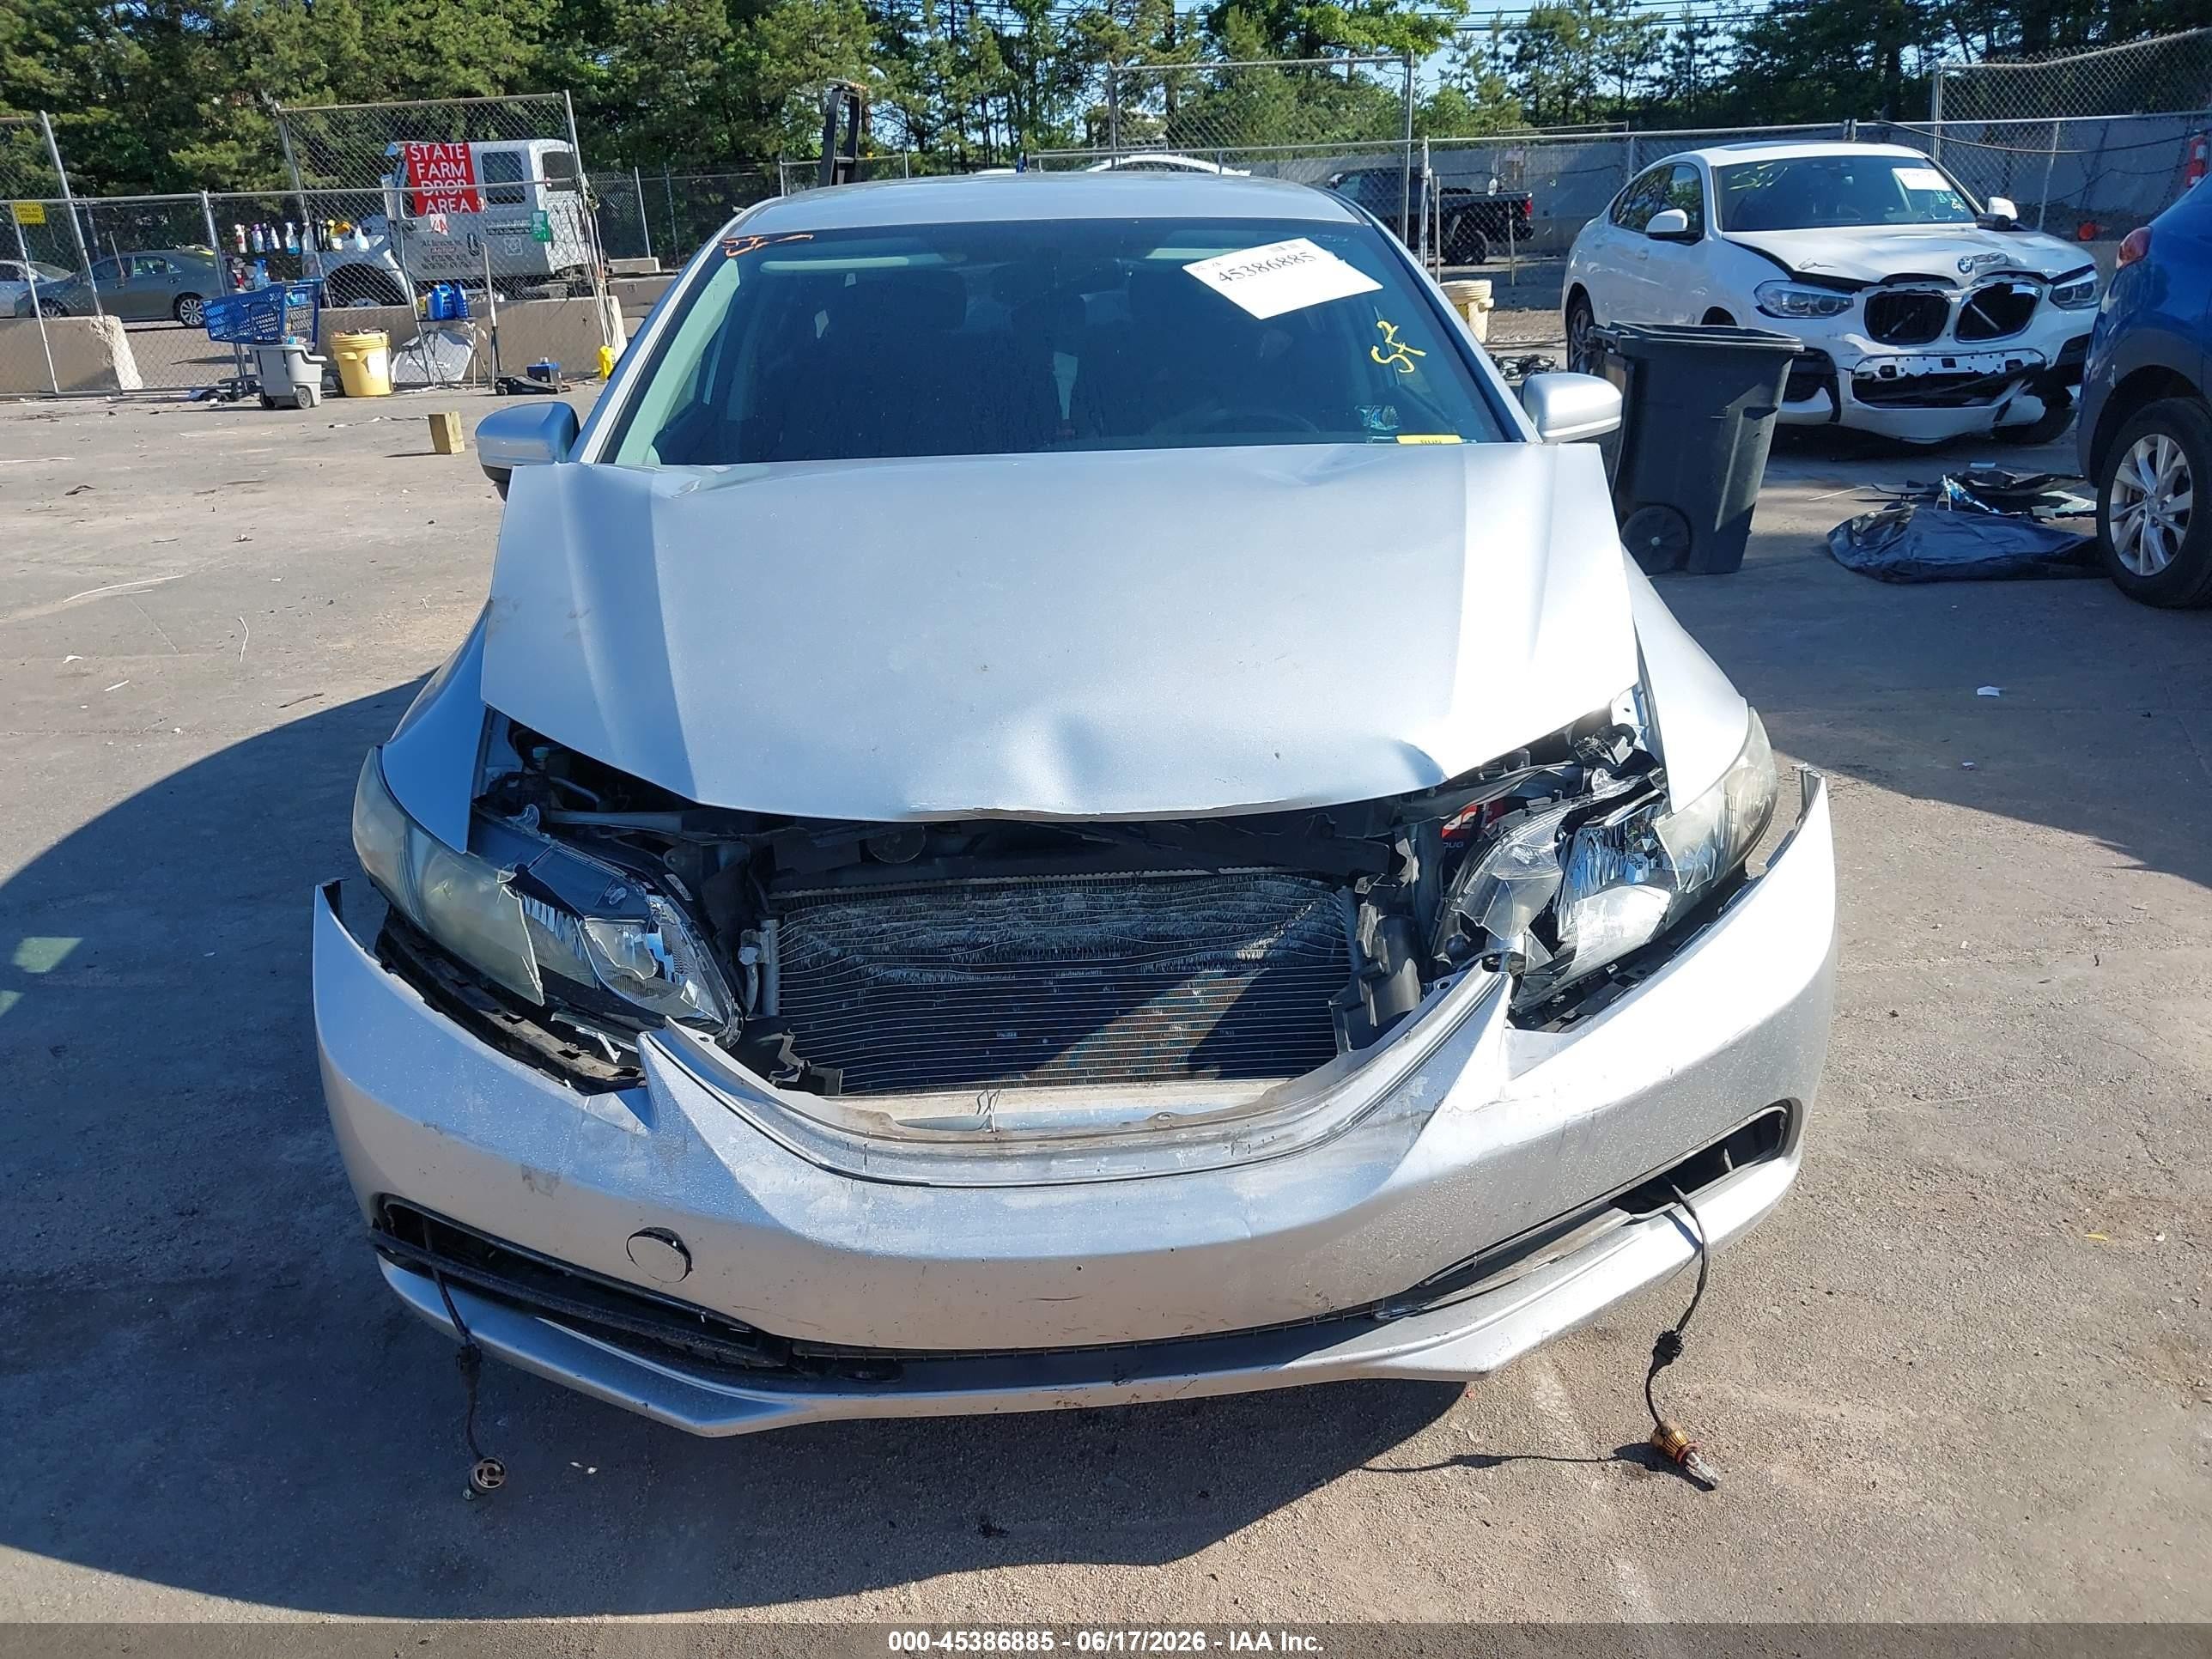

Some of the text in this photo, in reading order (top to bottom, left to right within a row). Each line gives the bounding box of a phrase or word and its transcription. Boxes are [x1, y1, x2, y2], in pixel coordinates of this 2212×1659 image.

[410, 143, 466, 161] STATE
[416, 161, 467, 179] FARM
[420, 179, 467, 197] DROP
[425, 198, 473, 214] AREA
[1218, 251, 1317, 283] 45386885
